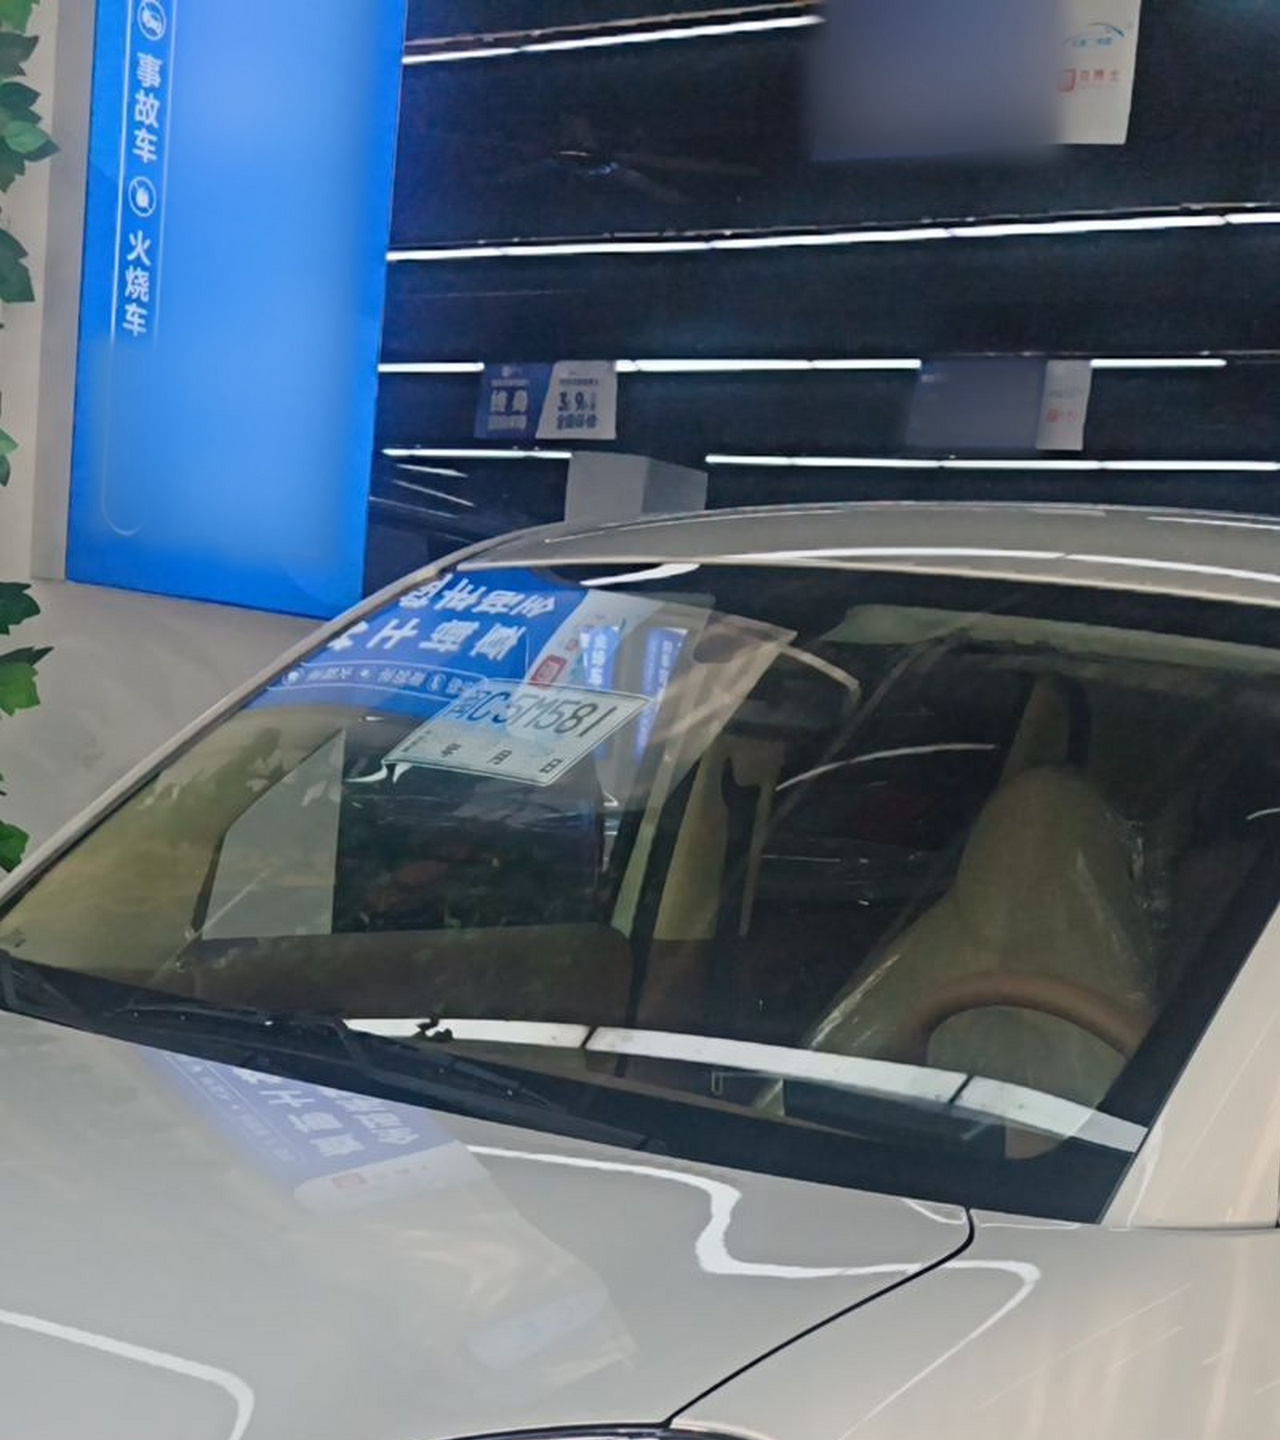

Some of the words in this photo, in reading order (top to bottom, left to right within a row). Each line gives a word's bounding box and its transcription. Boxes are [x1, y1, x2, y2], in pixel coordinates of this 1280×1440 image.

[131, 52, 163, 163] 事故车
[121, 229, 152, 337] 火烧车
